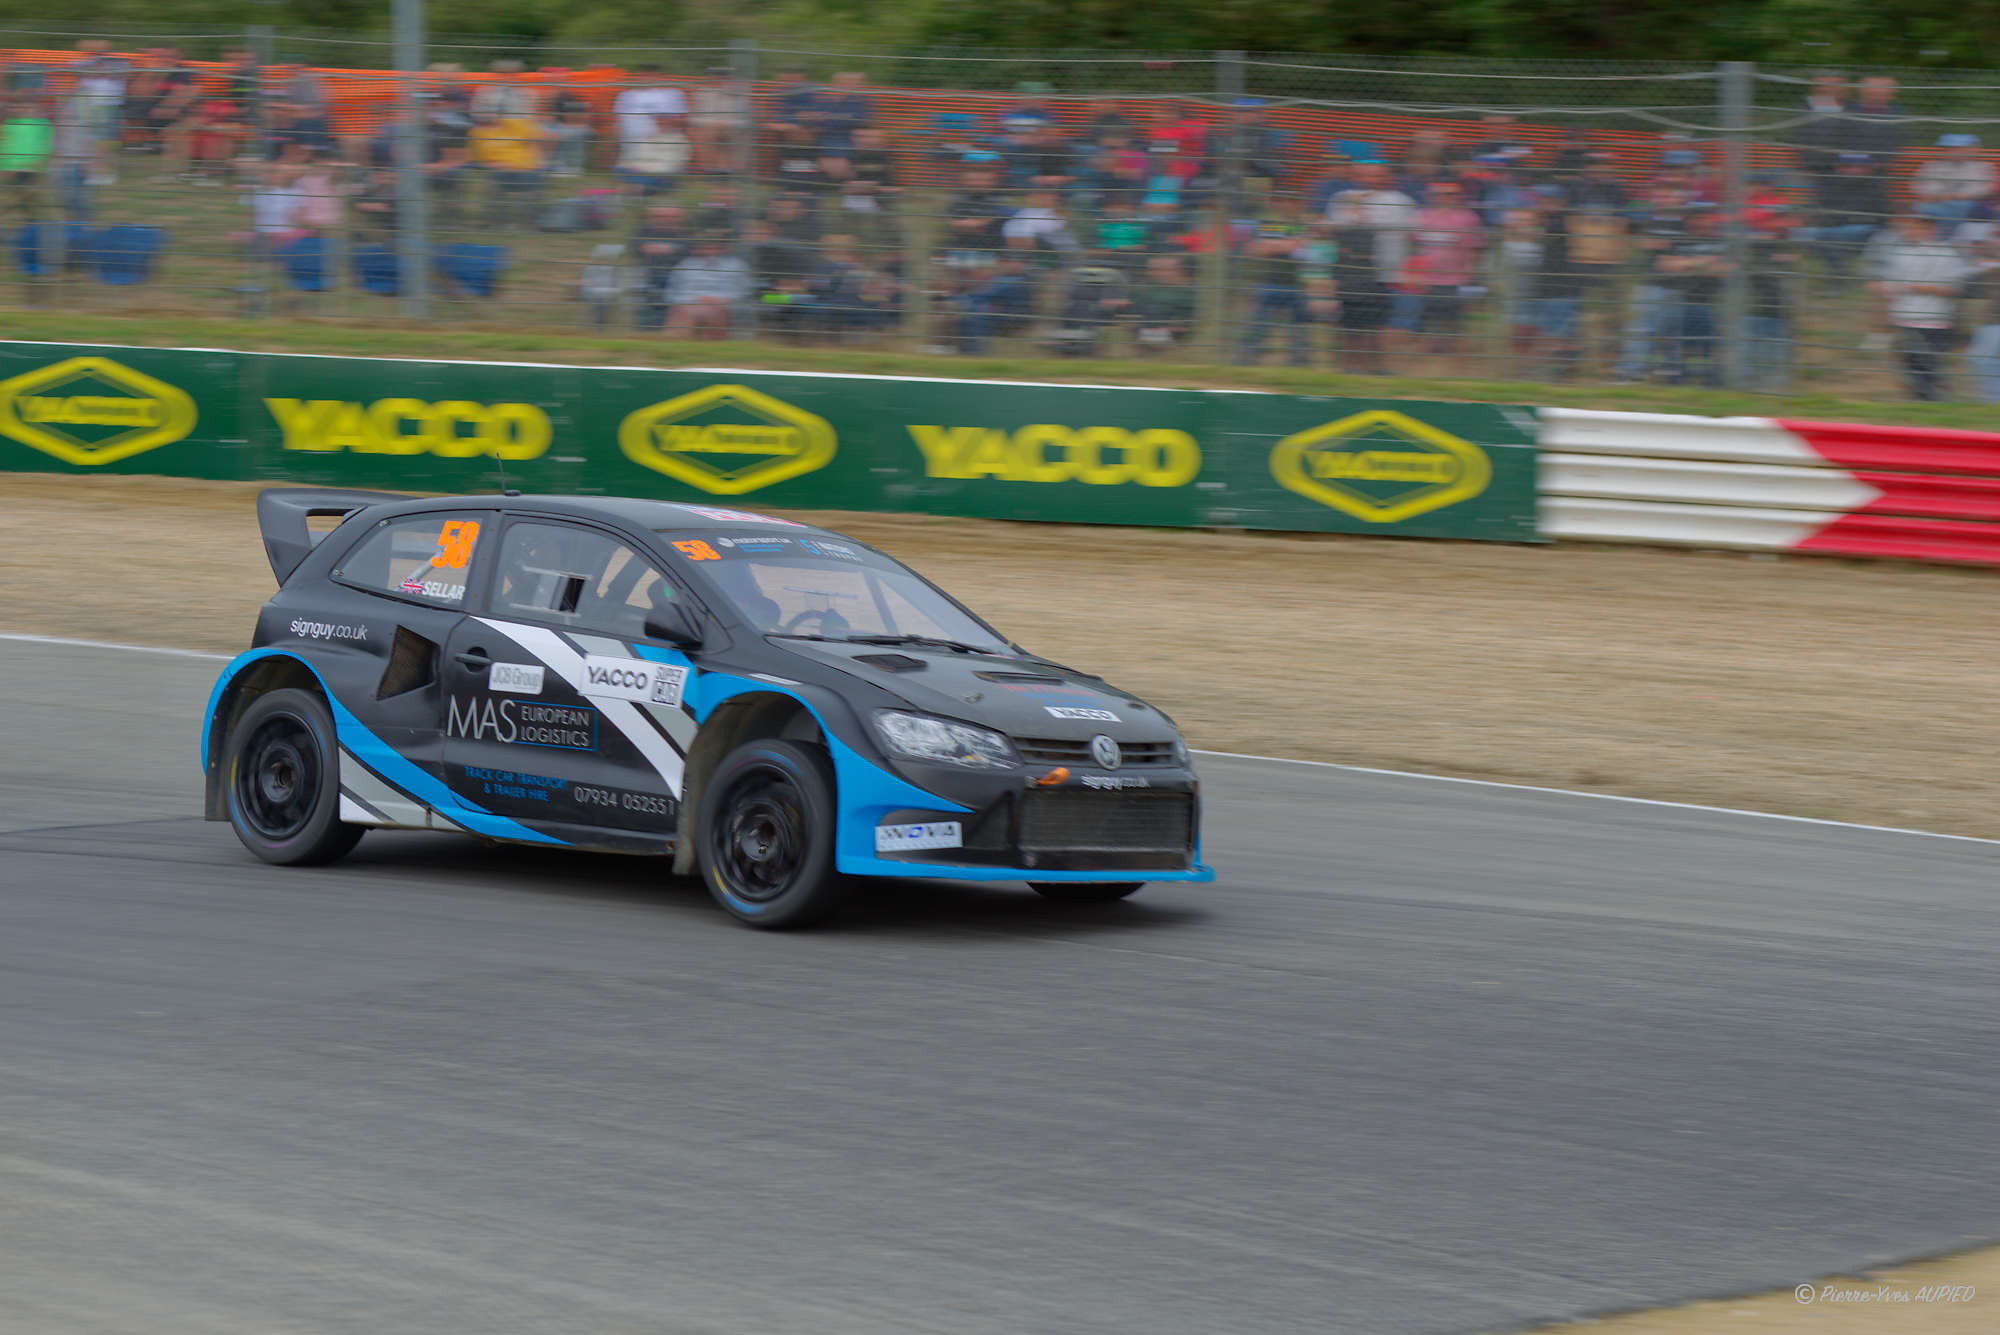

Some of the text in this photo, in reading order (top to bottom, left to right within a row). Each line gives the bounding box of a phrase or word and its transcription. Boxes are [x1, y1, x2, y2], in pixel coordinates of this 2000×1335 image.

[264, 398, 553, 460] YACCO
[906, 424, 1200, 487] YACCO
[431, 520, 480, 569] 58
[671, 539, 722, 560] 58
[422, 581, 466, 600] SELLAR
[290, 617, 368, 640] signguy.co.uk
[588, 665, 648, 690] YACCO
[447, 694, 517, 743] MAS
[521, 705, 590, 727] EUROPEAN
[521, 725, 589, 747] LOGISTICS
[574, 786, 618, 807] 07934
